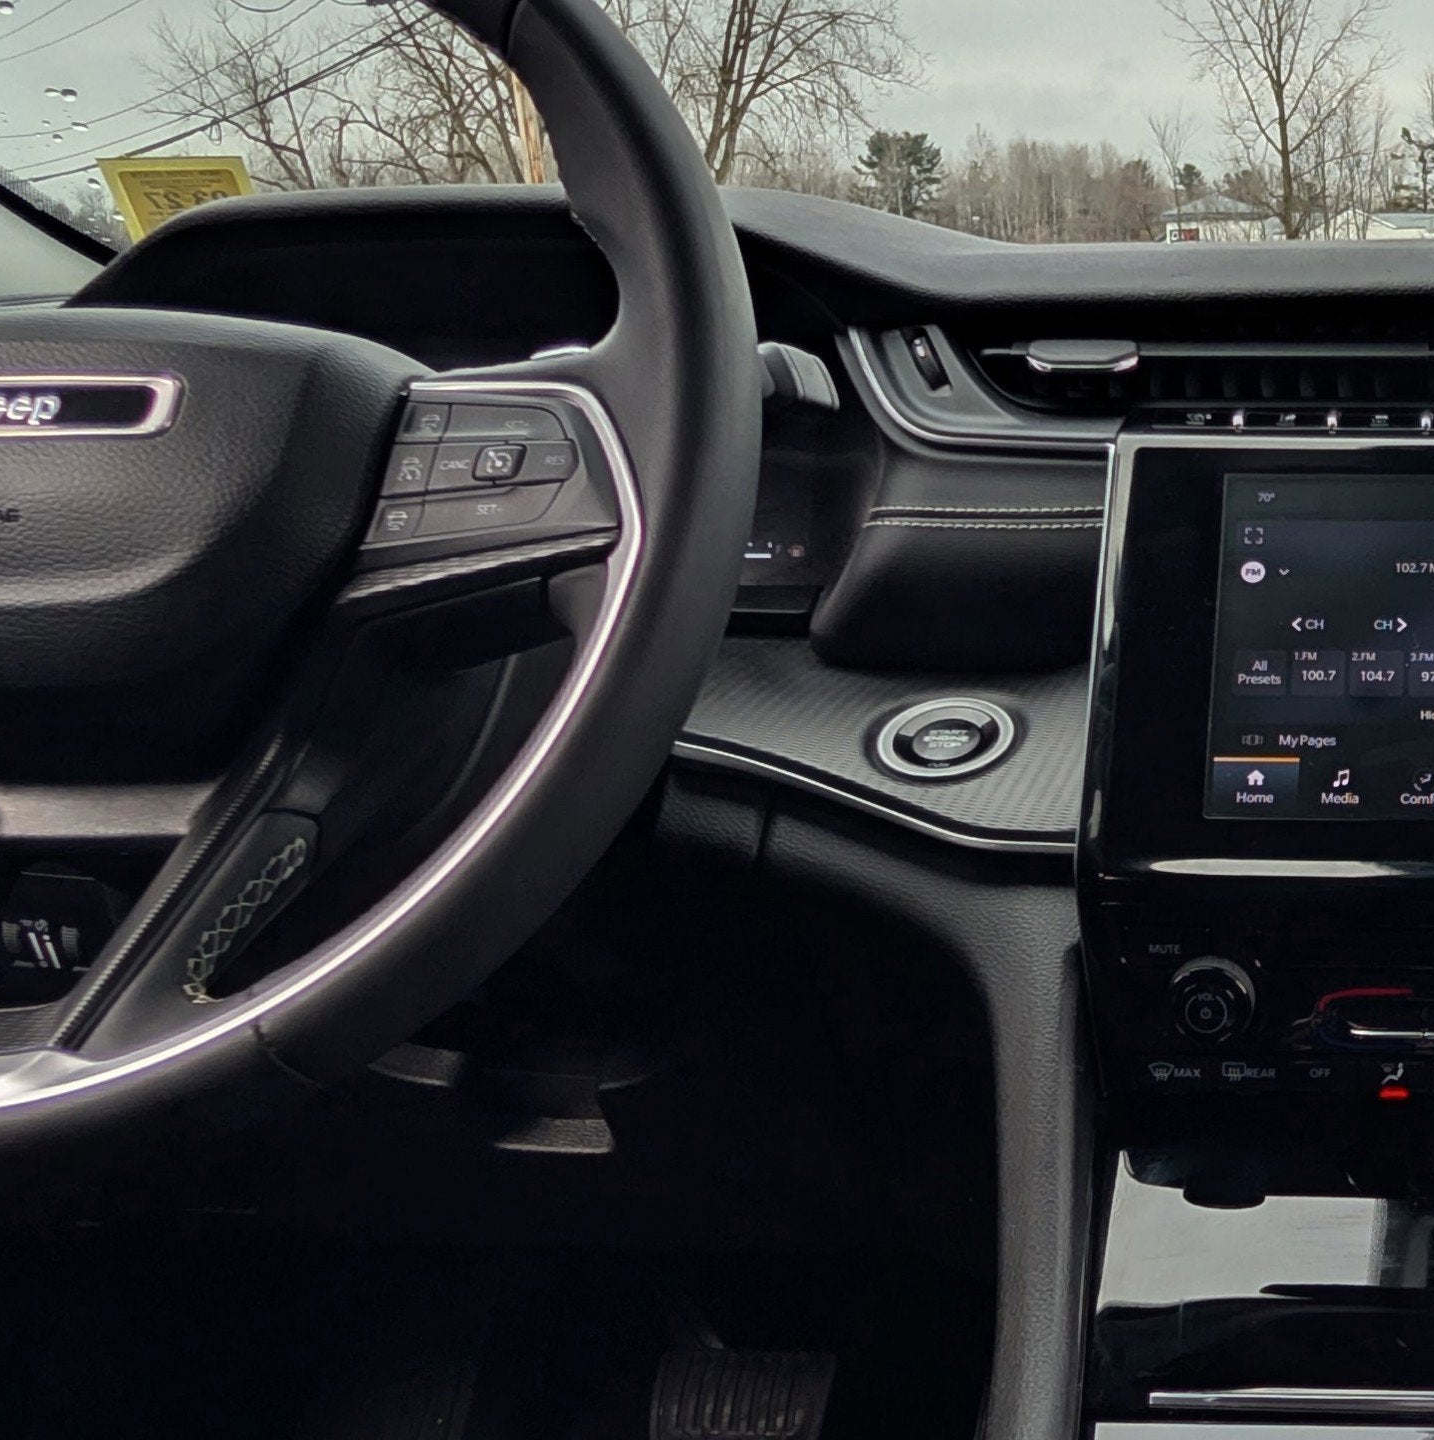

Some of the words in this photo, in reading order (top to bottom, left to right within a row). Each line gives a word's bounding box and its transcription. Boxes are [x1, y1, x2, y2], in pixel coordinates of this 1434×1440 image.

[1245, 567, 1262, 577] FM
[1305, 619, 1325, 630] CH
[1374, 619, 1393, 630] CH
[1252, 661, 1268, 672] All
[1237, 674, 1282, 686] Presets
[1302, 670, 1337, 682] 100.7
[1360, 670, 1396, 682] 104.7
[1279, 735, 1297, 748] My
[1299, 735, 1337, 748] Pages
[1236, 792, 1274, 804] Home
[1321, 793, 1360, 805] Media
[1148, 944, 1182, 955] MUTE
[1174, 1068, 1202, 1078] MAX
[1246, 1068, 1276, 1078] REAR
[1309, 1068, 1332, 1079] OFF
